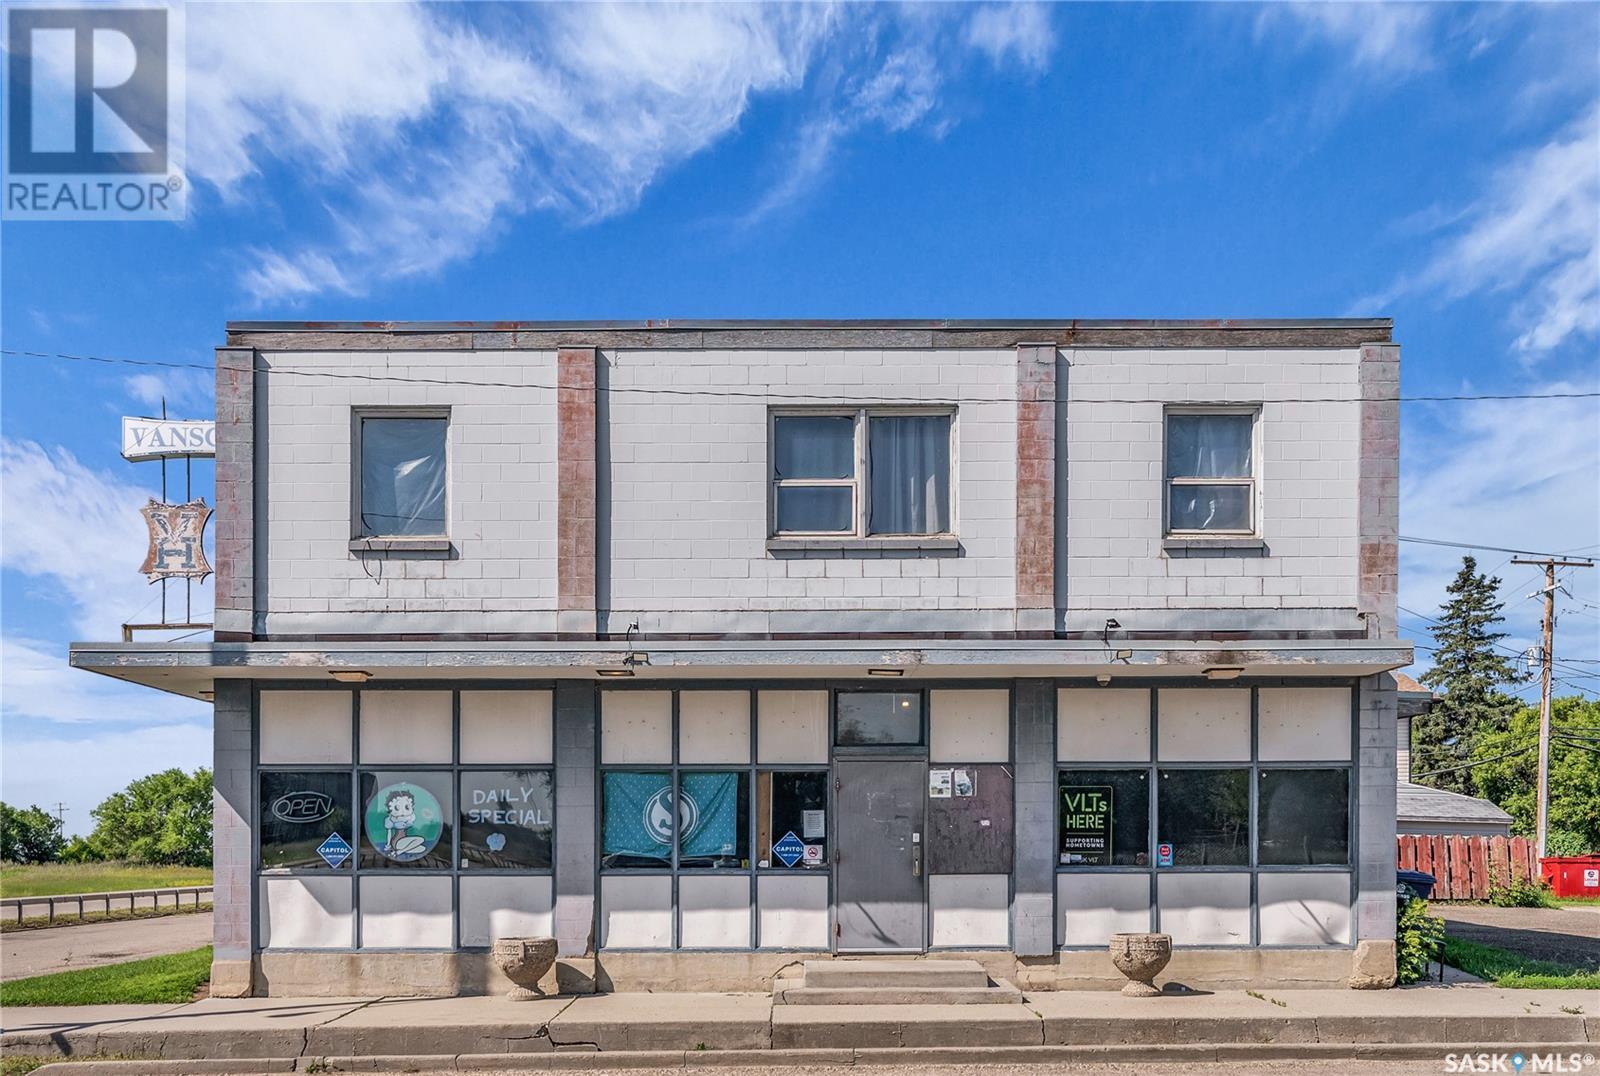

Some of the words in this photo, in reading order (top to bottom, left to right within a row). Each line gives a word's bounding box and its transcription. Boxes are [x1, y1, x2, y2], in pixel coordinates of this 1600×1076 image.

[473, 787, 534, 805] DAILY
[1064, 793, 1108, 812] VLTs
[275, 798, 332, 816] OPEN
[468, 809, 550, 826] SPECIAL
[1066, 815, 1105, 829] HERE
